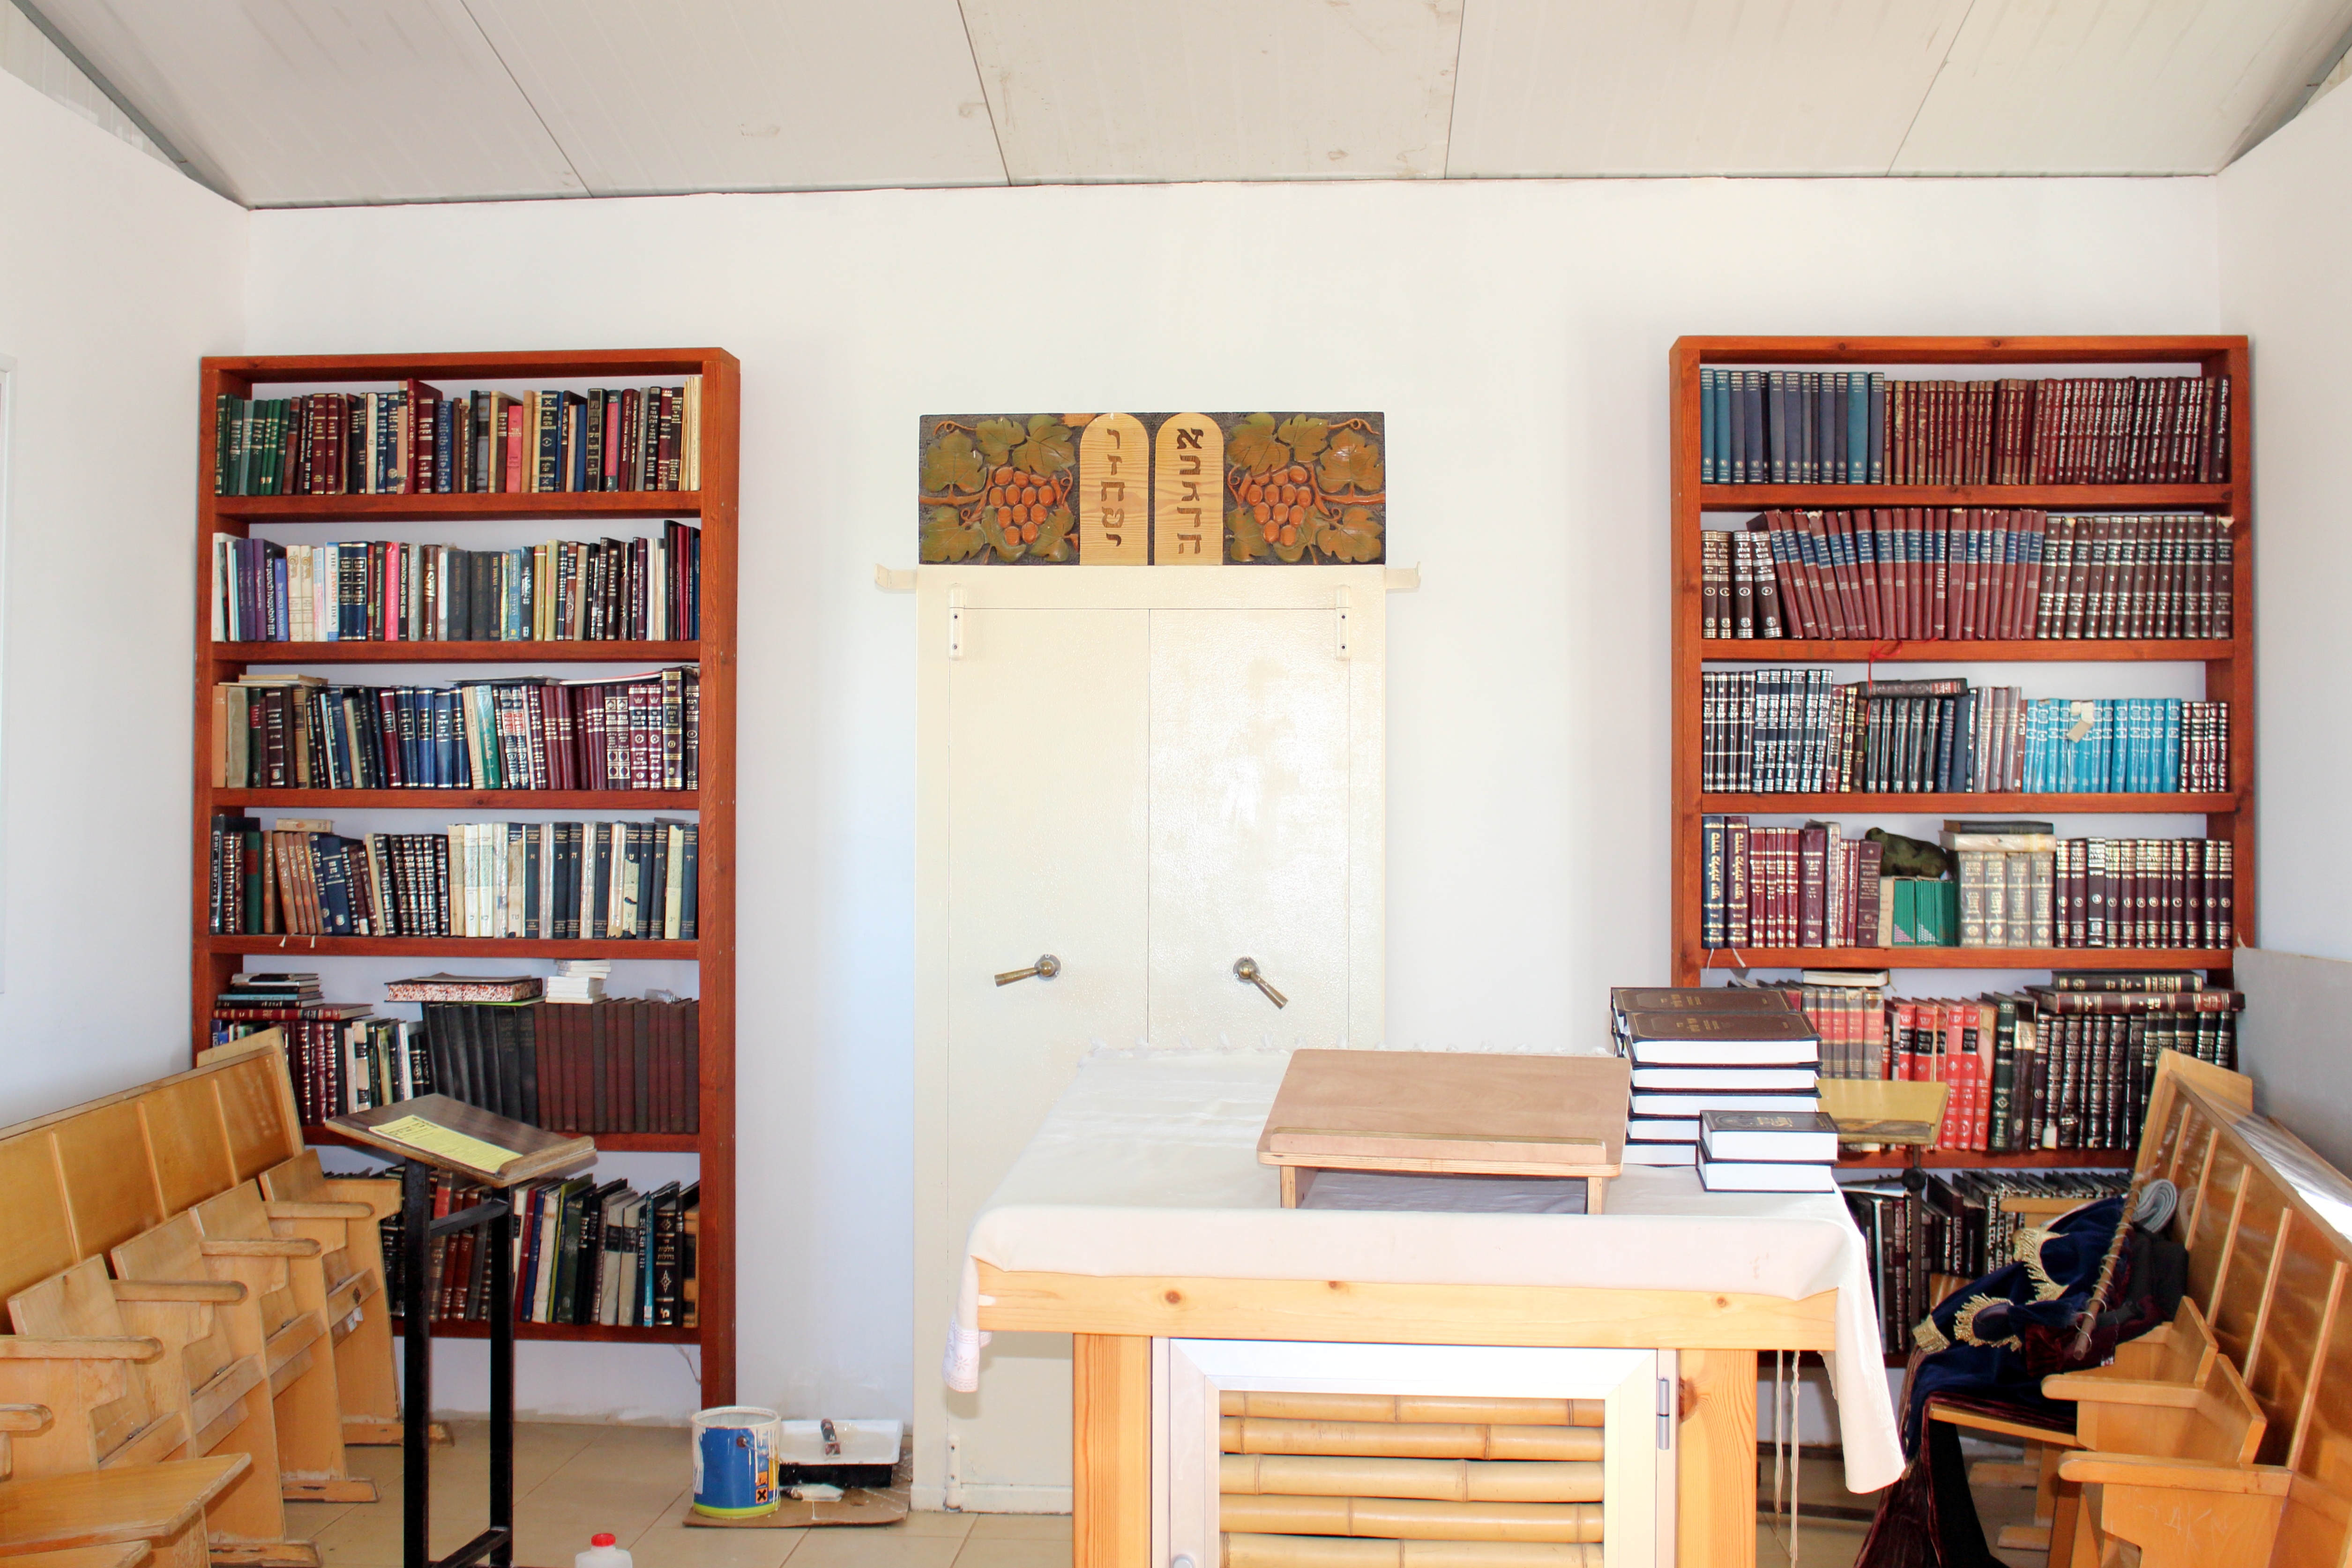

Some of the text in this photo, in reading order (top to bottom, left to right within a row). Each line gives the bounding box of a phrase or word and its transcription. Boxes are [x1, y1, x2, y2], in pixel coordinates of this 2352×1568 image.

[1106, 428, 1120, 449] ו
[1176, 427, 1204, 449] א
[1107, 454, 1122, 475] ז
[1179, 454, 1201, 475] ב
[1100, 480, 1125, 502] ח
[1181, 480, 1200, 501] ג
[1101, 506, 1125, 528] ט
[1177, 506, 1202, 528] ד
[1105, 532, 1122, 547] י
[1177, 532, 1202, 554] ה
[1711, 832, 1721, 854] סדור
[1735, 832, 1744, 854] סדור
[1711, 883, 1721, 900] יופי
[1735, 883, 1744, 900] יופי
[1987, 1196, 1996, 1226] תלמוד
[1953, 1217, 1962, 1270] תלמוד בבלי
[1986, 1226, 1996, 1249] בבלי
